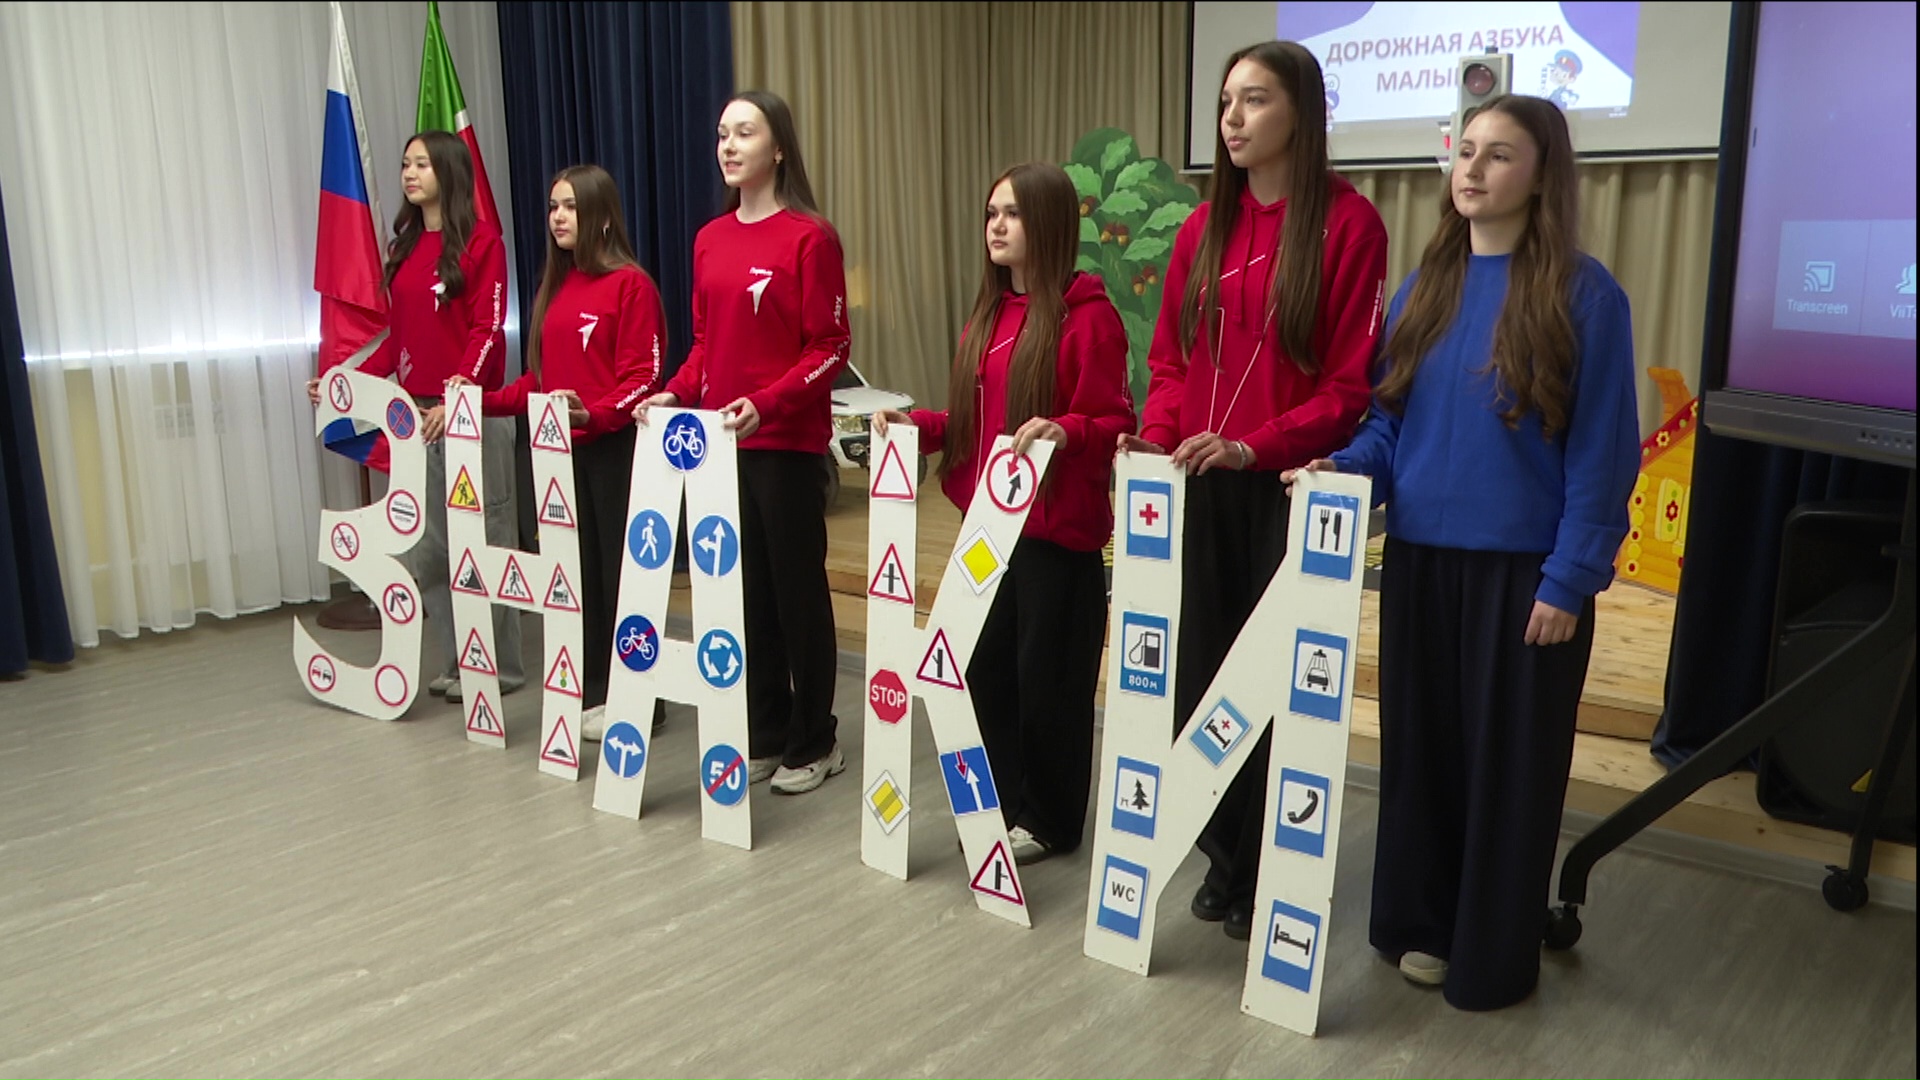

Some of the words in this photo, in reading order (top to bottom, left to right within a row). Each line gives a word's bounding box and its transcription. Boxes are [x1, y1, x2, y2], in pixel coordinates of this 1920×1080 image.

[1325, 33, 1462, 66] ДОРОЖНАЯ
[1468, 24, 1564, 51] АЗБУКА
[1376, 67, 1459, 93] МАЛЫ
[1786, 299, 1848, 315] Transcreen
[871, 684, 906, 708] STOP
[709, 760, 741, 791] 50
[1111, 880, 1136, 902] WC
